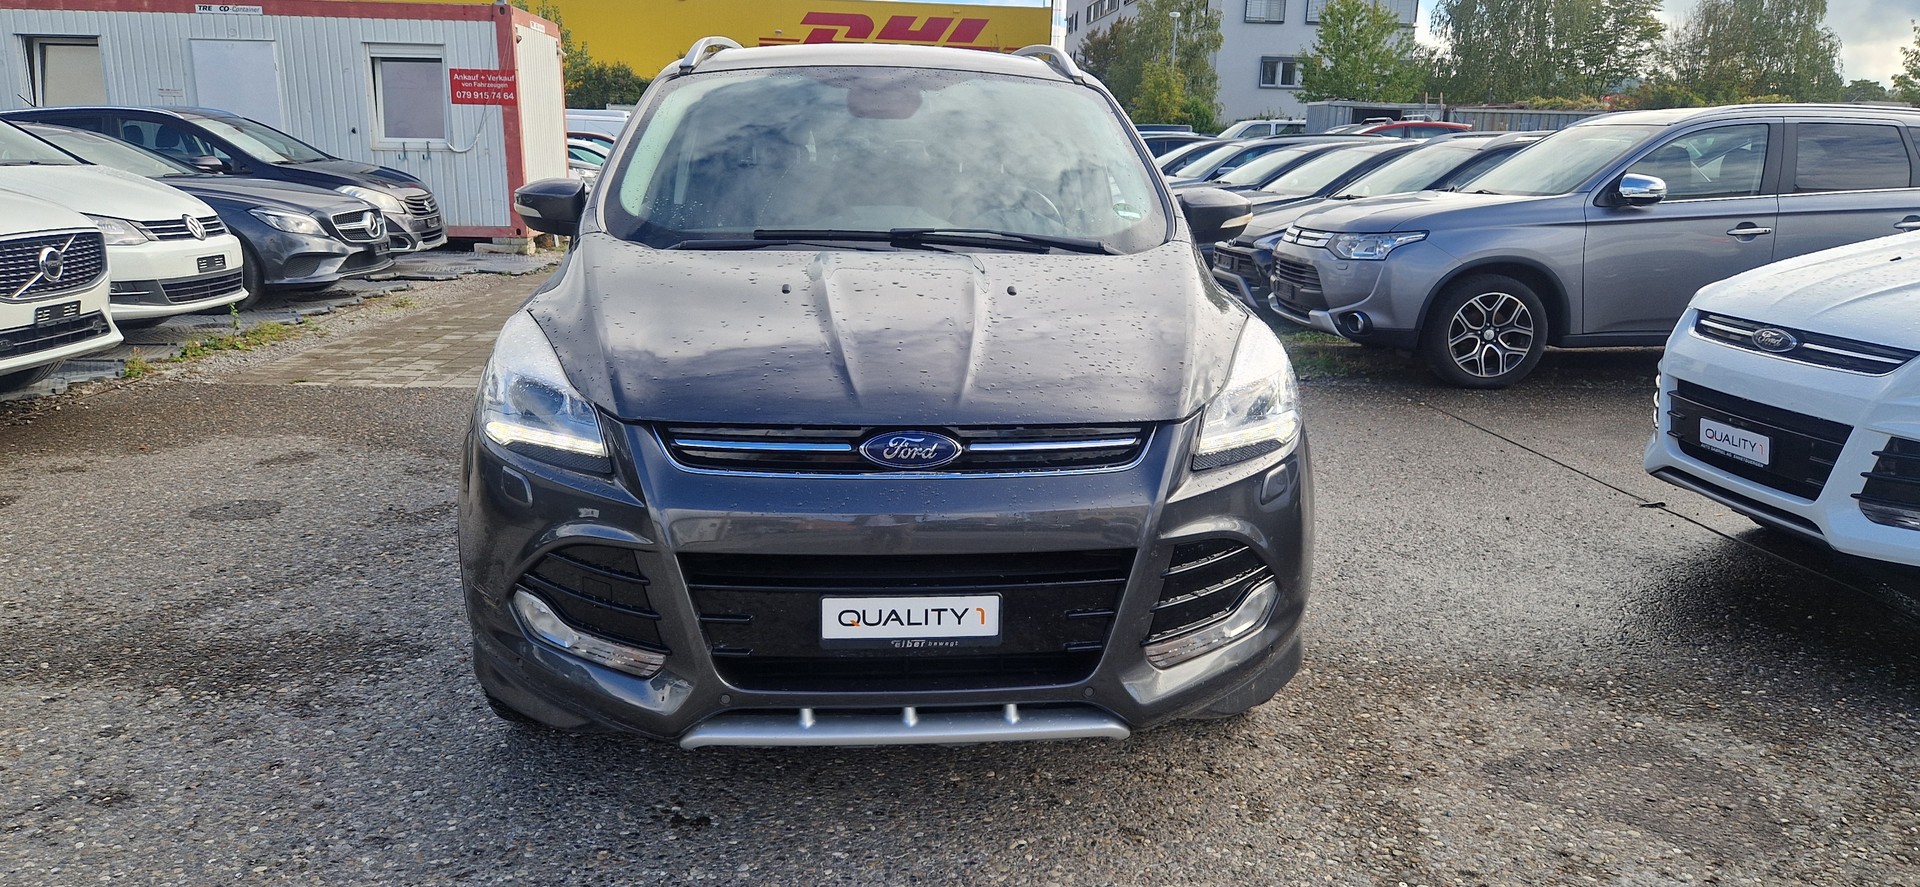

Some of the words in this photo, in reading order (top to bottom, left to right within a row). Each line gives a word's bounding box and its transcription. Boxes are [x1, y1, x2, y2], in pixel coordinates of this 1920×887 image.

[456, 90, 472, 99] 079
[473, 91, 489, 100] 915
[491, 91, 501, 99] 74
[503, 92, 514, 100] 64
[1758, 331, 1784, 346] Ford
[883, 436, 938, 459] Ford
[1705, 428, 1757, 452] QUALITY
[1759, 443, 1764, 456] 1
[838, 608, 969, 627] QUALITY
[976, 607, 985, 625] 1
